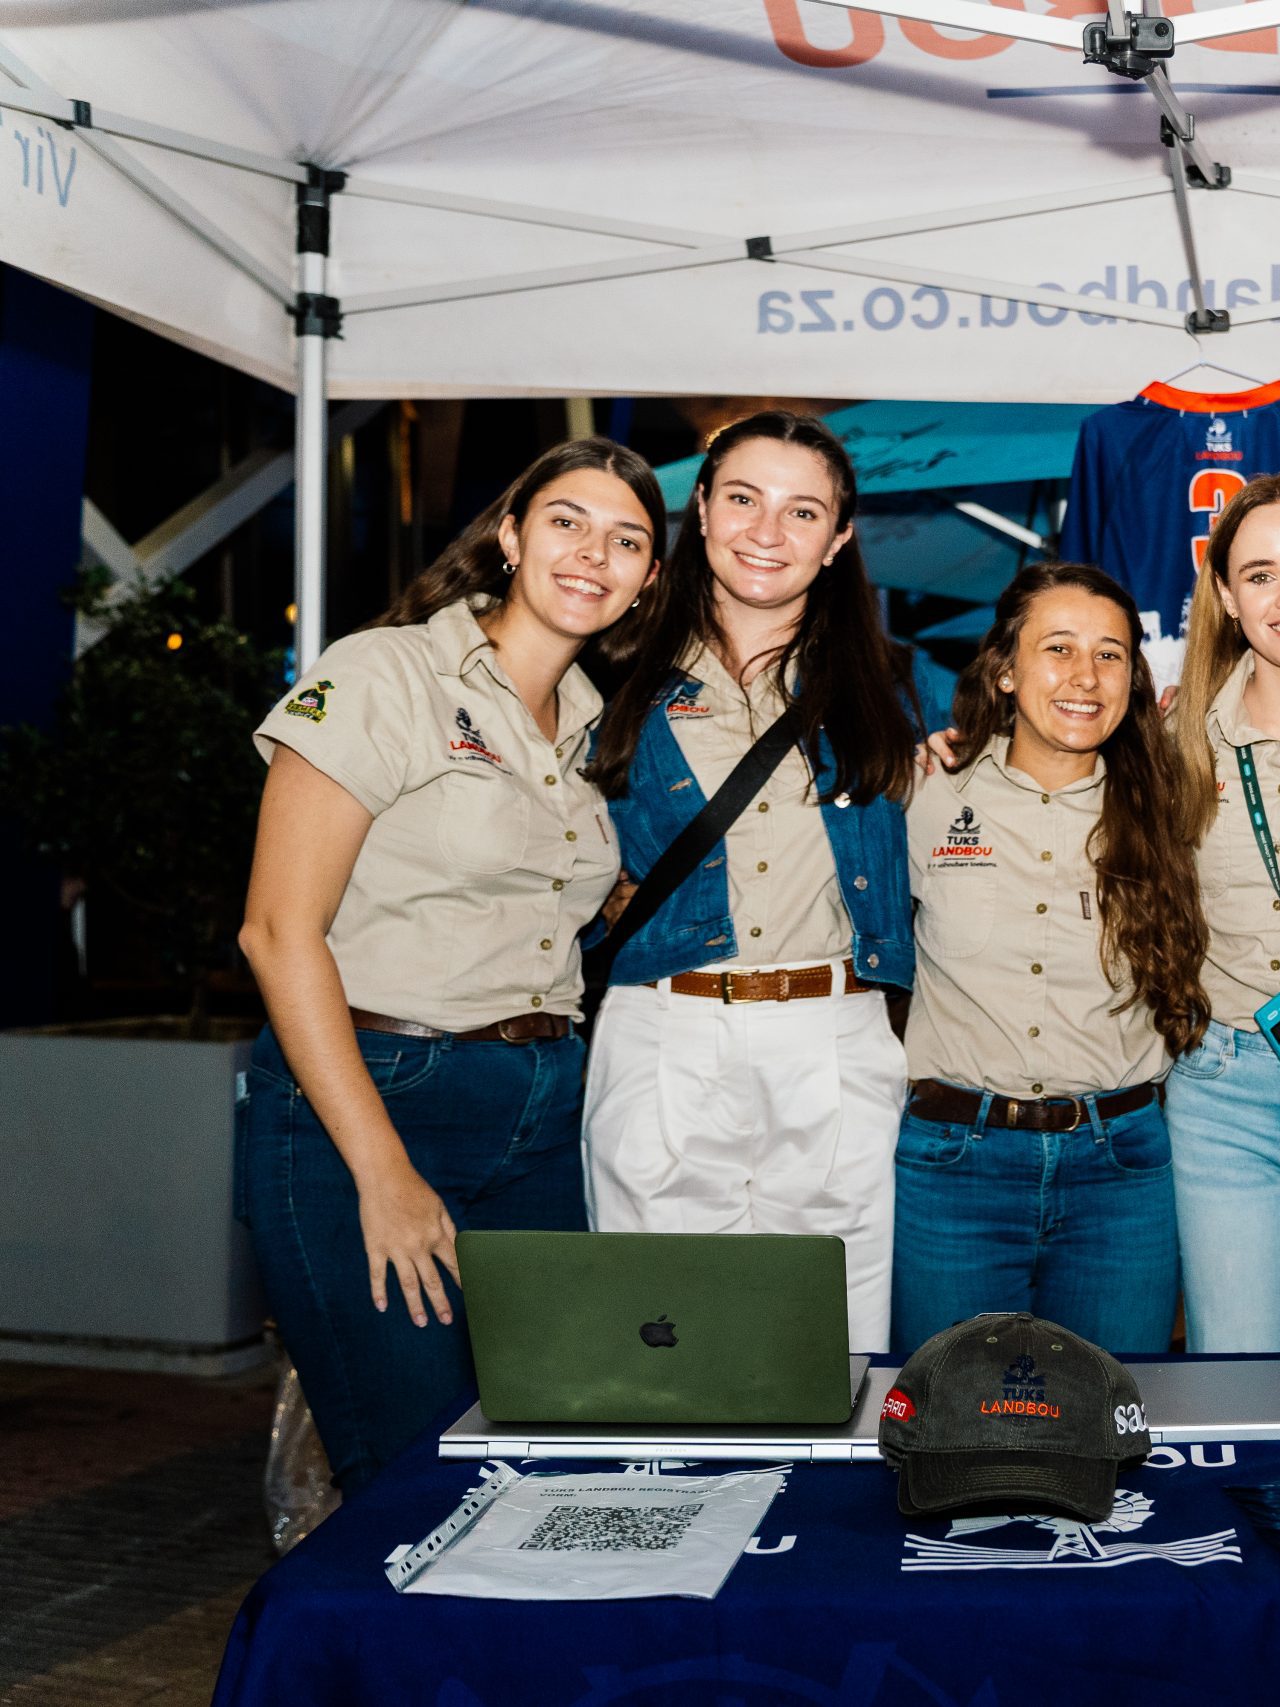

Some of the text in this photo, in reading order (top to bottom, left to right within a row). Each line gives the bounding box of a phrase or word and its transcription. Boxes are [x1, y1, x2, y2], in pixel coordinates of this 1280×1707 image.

[946, 835, 979, 846] TUKS
[932, 846, 993, 857] LANDBOU
[1002, 1387, 1044, 1401] TUKS
[980, 1399, 1059, 1418] LANDBOU
